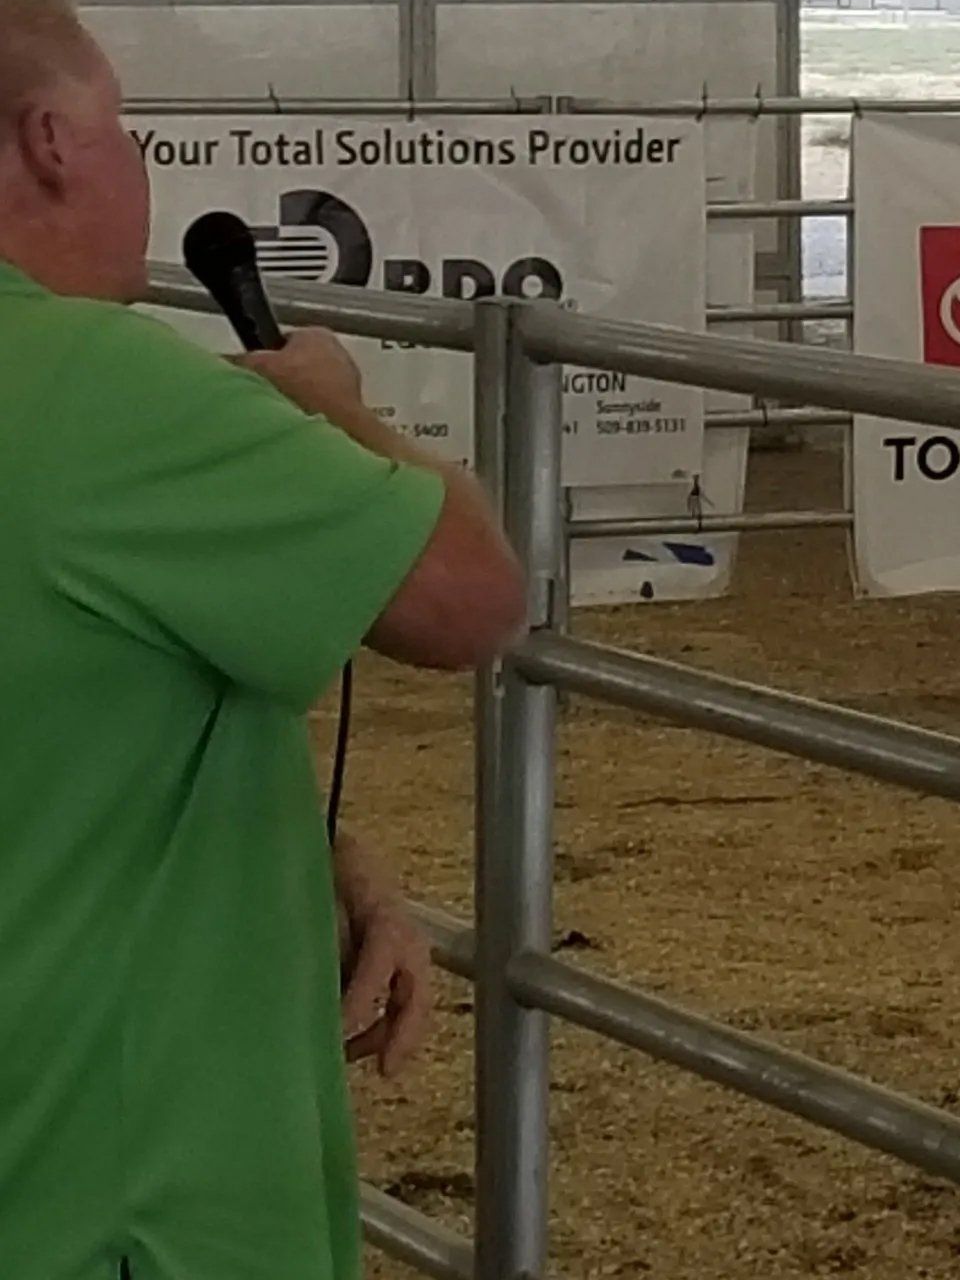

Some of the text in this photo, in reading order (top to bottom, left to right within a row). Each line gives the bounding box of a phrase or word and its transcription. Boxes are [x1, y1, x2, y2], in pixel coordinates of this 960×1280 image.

[130, 129, 681, 166] Your Total Solutions Provider
